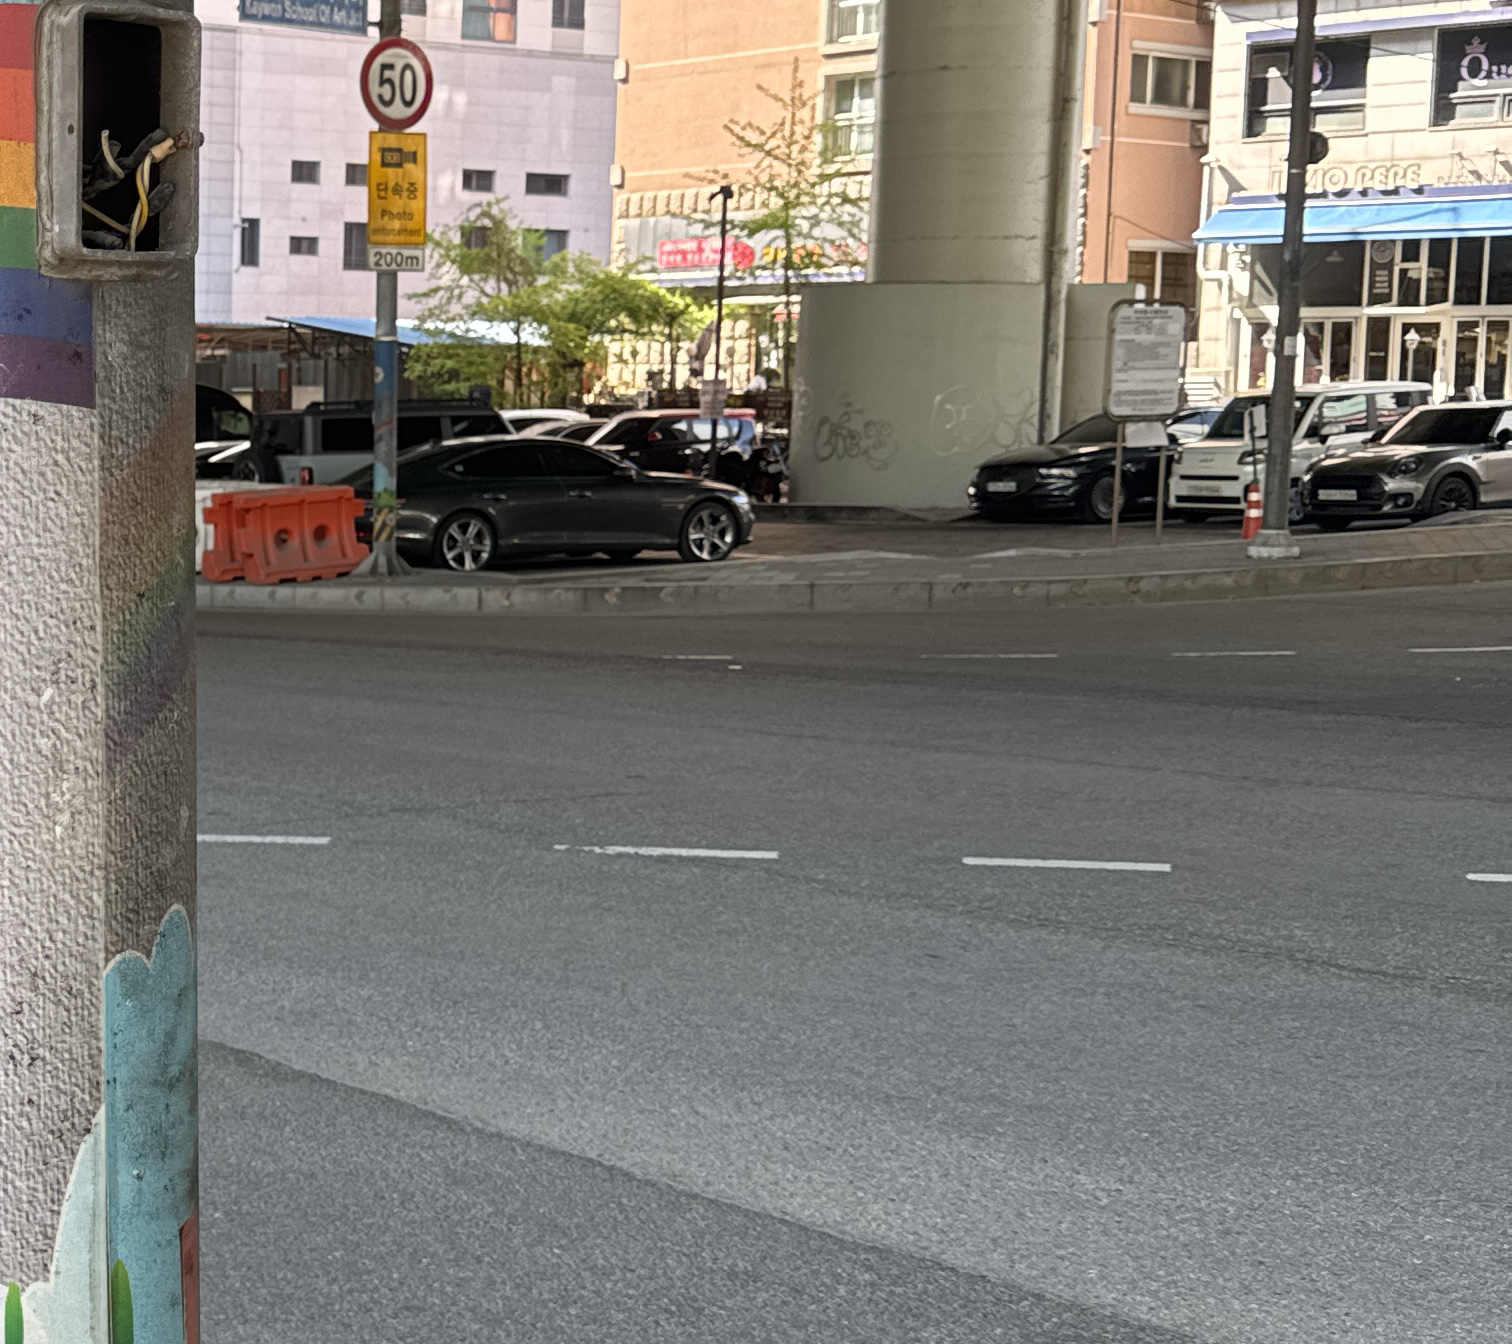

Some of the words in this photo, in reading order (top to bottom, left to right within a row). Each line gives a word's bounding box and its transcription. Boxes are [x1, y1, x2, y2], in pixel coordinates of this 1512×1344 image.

[377, 63, 418, 109] 50
[1355, 163, 1421, 191] PEPE
[375, 181, 419, 201] 단속중
[380, 209, 414, 222] Photo
[373, 251, 420, 268] 200m
